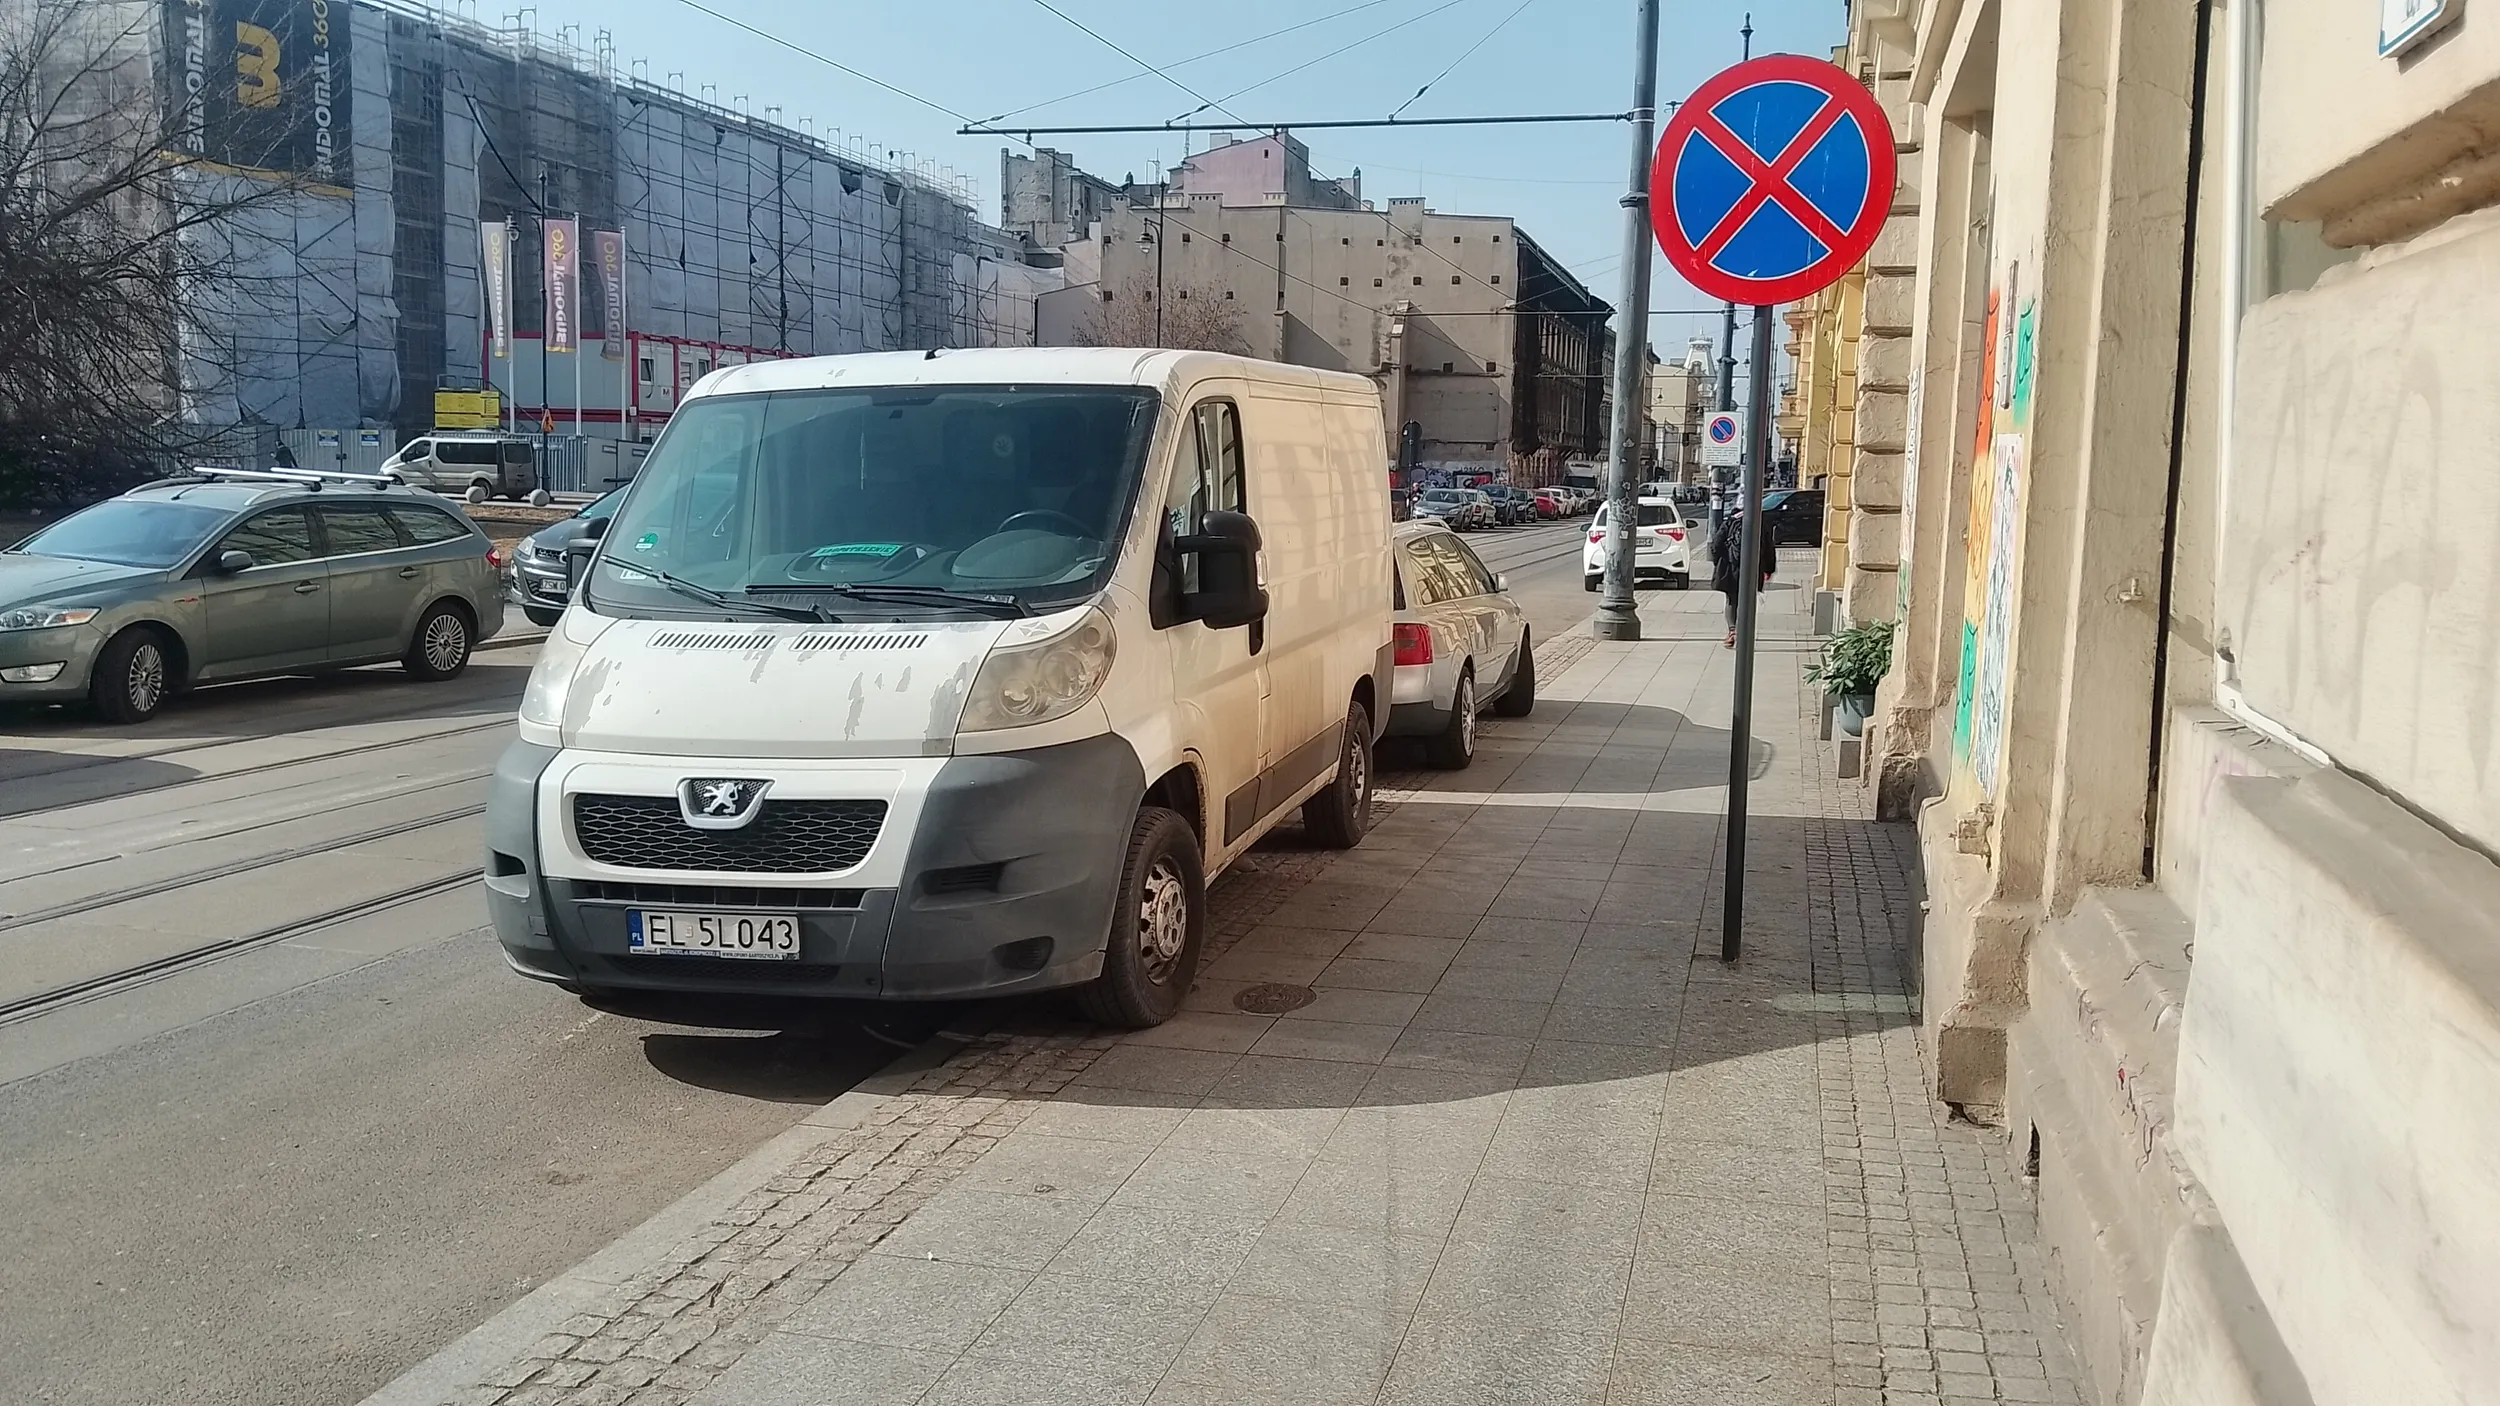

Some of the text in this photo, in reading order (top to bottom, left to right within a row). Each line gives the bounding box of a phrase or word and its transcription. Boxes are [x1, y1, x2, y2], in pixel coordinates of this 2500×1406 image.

[631, 932, 643, 941] PL
[649, 915, 793, 950] EL 5L043
